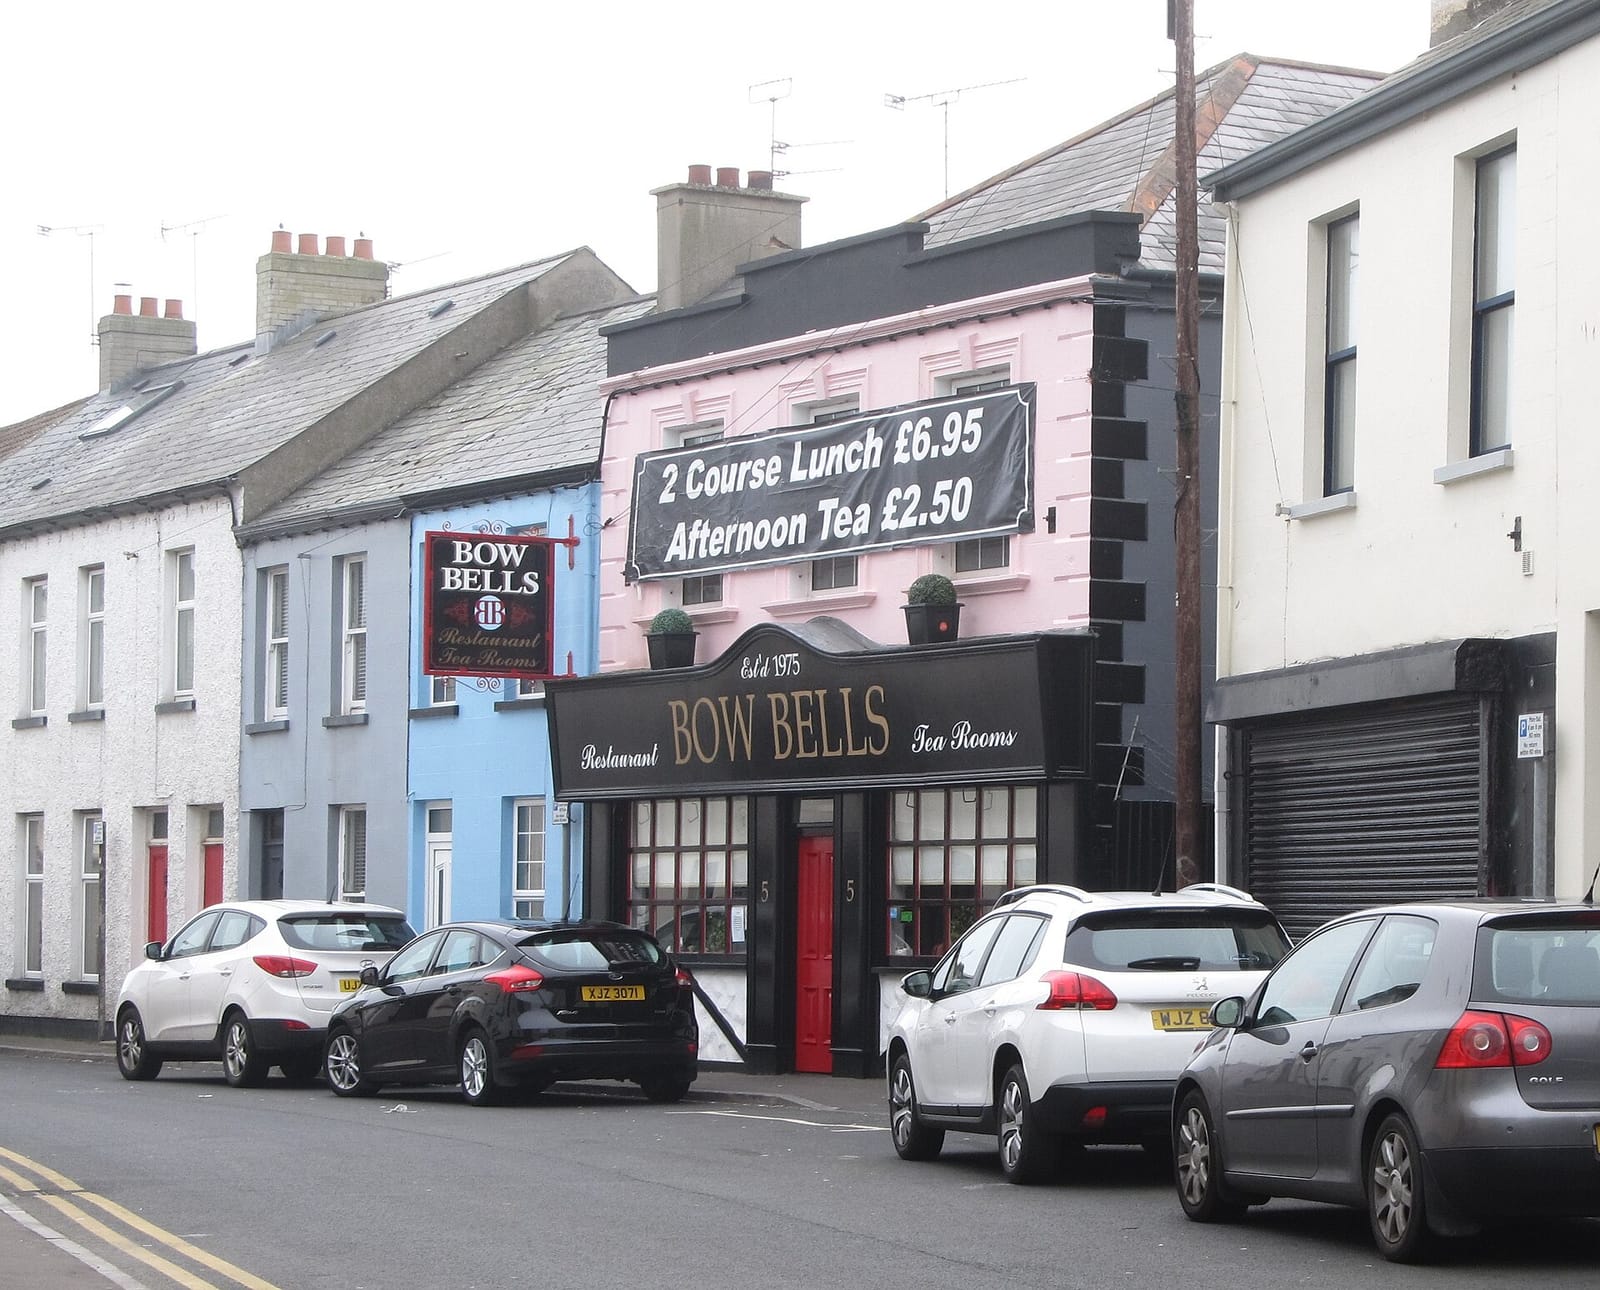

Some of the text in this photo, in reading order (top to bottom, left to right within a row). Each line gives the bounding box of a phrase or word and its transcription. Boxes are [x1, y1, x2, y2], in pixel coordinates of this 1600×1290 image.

[659, 407, 985, 504] 2 Course Lunch £6.95
[664, 476, 973, 562] Afternoon Tea £2.50
[452, 541, 529, 567] BOW
[441, 567, 540, 595] BELLS
[439, 627, 541, 648] Restaurant
[438, 647, 539, 668] Tea Rooms
[772, 653, 801, 678] 1975
[668, 684, 891, 766] BOW BELLS
[911, 719, 1018, 754] Tea Rooms
[580, 742, 659, 771] Restaurant
[761, 880, 769, 903] 5
[846, 879, 855, 902] 5
[588, 987, 638, 999] XJZ 3071
[1160, 1011, 1195, 1026] WJZ
[1528, 1076, 1565, 1084] GOLF
